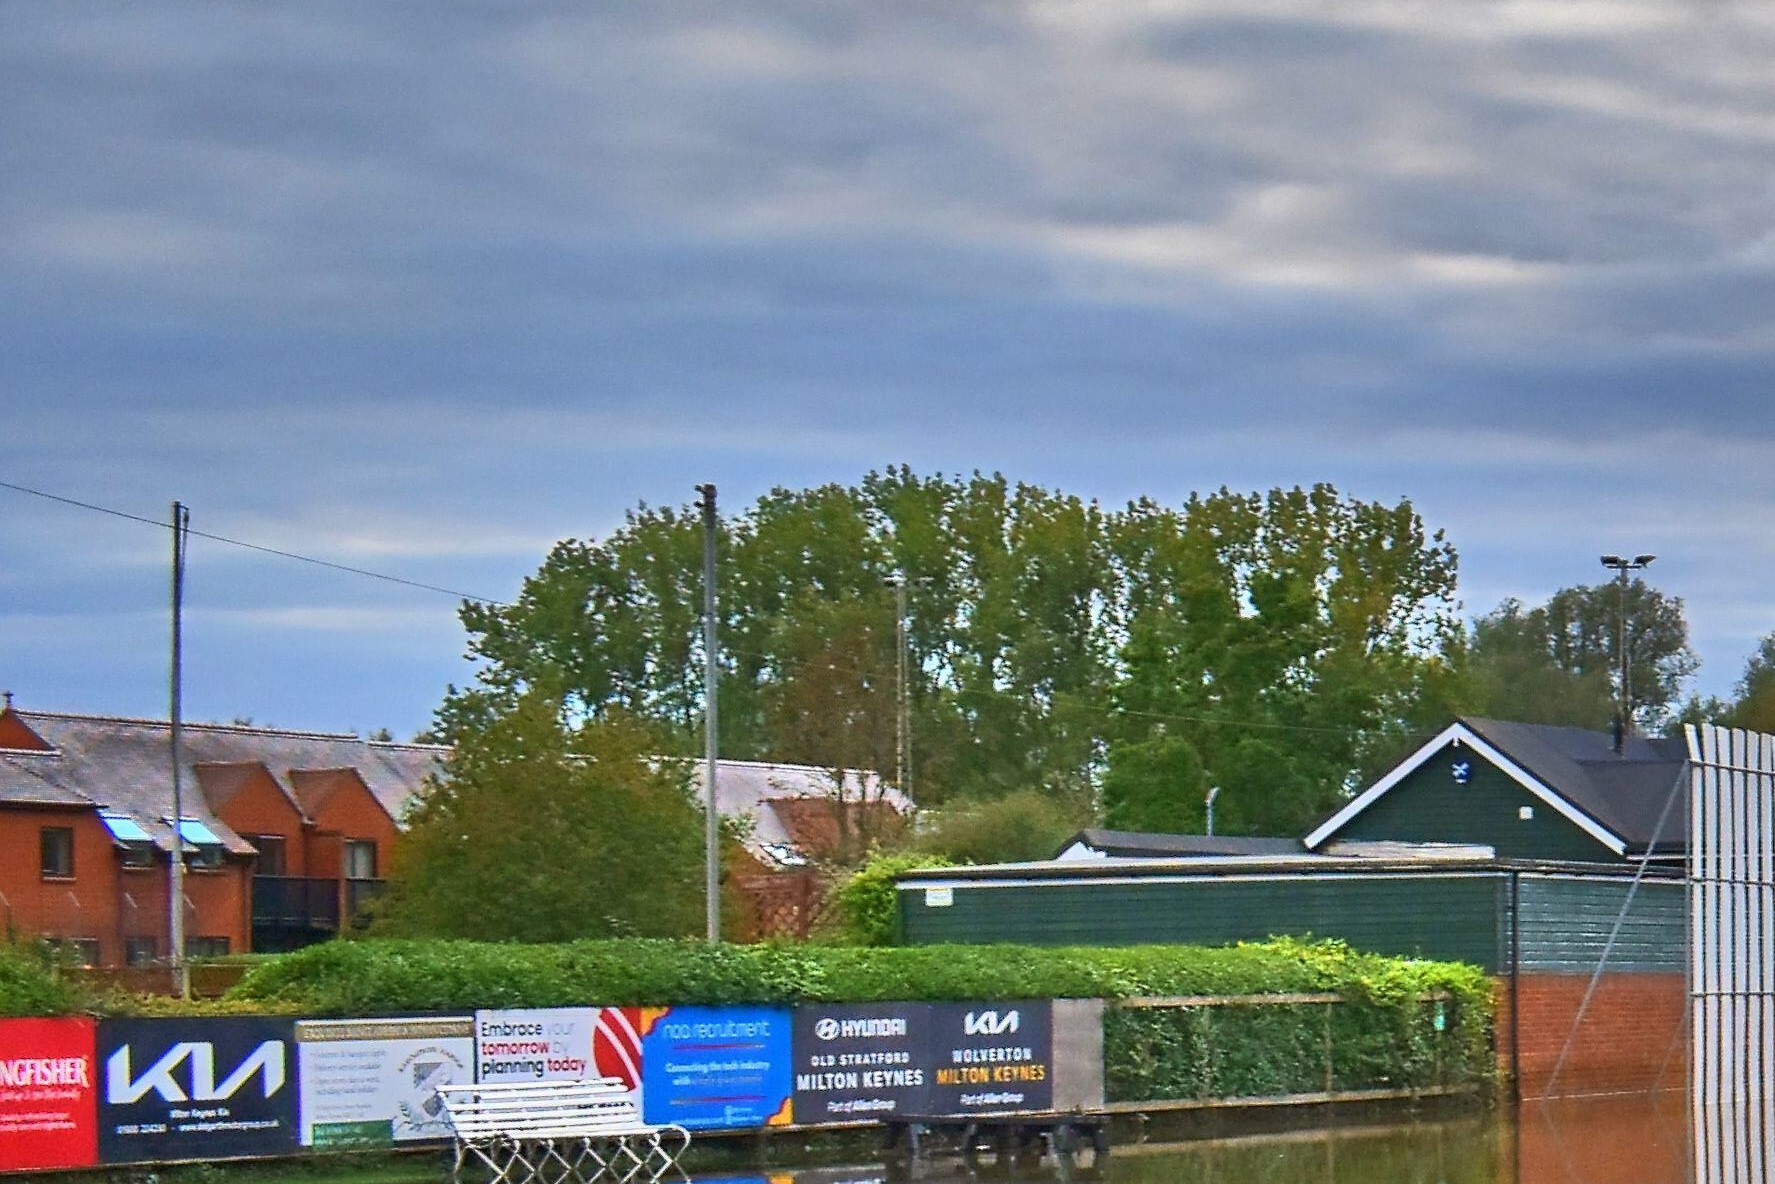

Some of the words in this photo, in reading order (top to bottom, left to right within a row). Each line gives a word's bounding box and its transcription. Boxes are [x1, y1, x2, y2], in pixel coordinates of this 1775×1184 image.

[481, 1021, 543, 1037] Embrace
[841, 1019, 907, 1037] HYUNDAI
[964, 1010, 1020, 1035] KIA
[481, 1042, 550, 1055] tomorrow
[952, 1047, 1033, 1063] WOLVERTON
[481, 1057, 544, 1080] planning
[547, 1057, 587, 1076] today
[810, 1054, 836, 1067] OLD
[839, 1052, 910, 1066] STRATFORD
[106, 1040, 286, 1104] KIA
[797, 1072, 858, 1091] MILTON
[863, 1069, 924, 1088] KEYNES
[936, 1067, 990, 1085] MILTON
[993, 1064, 1046, 1082] KEYNES
